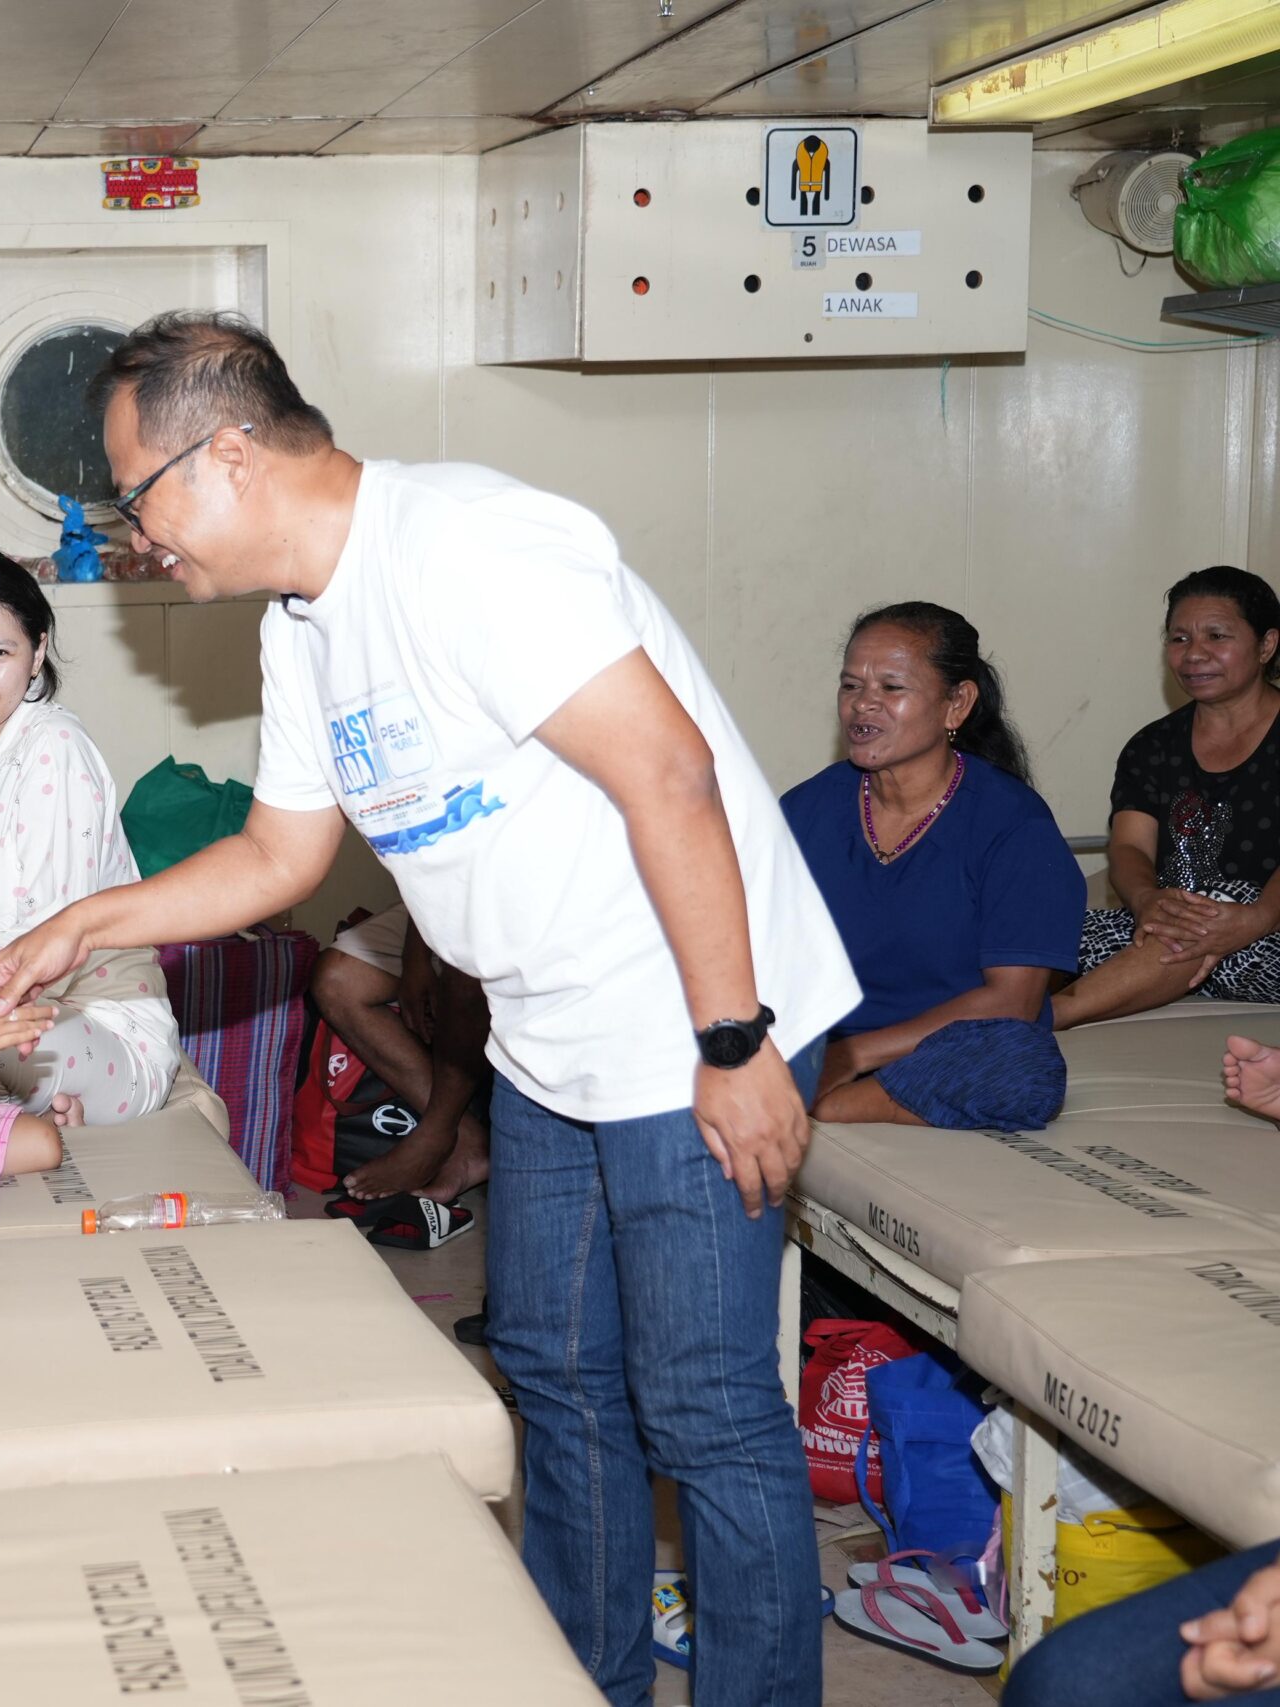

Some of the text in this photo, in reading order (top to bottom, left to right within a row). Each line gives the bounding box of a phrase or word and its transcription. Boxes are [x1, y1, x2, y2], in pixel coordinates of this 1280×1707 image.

[802, 236, 816, 257] 5
[827, 237, 897, 252] DEWASA
[824, 298, 883, 313] 1 ANAK
[380, 716, 419, 741] PELNI
[868, 1202, 920, 1257] MEI 2025
[78, 1276, 135, 1300] PELNI
[1184, 1262, 1265, 1290] TIDAK
[1044, 1371, 1122, 1448] MEI 2025
